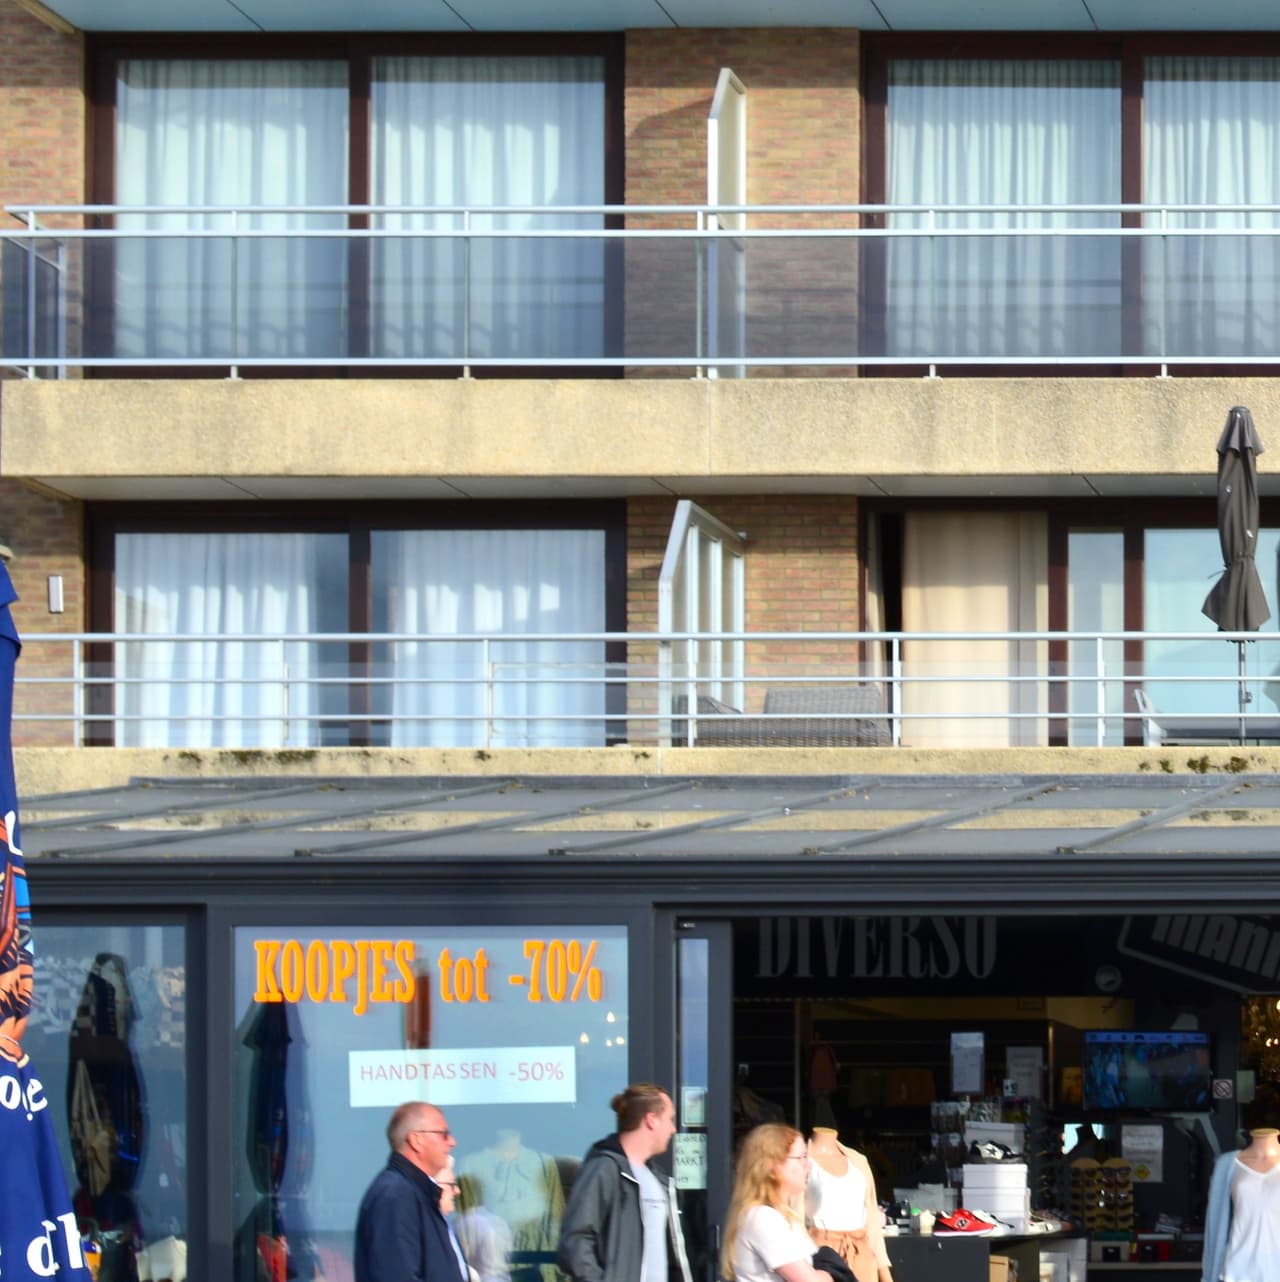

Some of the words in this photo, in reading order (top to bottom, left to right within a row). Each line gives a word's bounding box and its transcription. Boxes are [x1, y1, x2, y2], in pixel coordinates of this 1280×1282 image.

[254, 939, 417, 1015] KOOPJES
[438, 947, 490, 1003] tot
[508, 939, 602, 1002] -70%
[360, 1062, 497, 1081] HANDTASSEN
[507, 1062, 564, 1082] -50%
